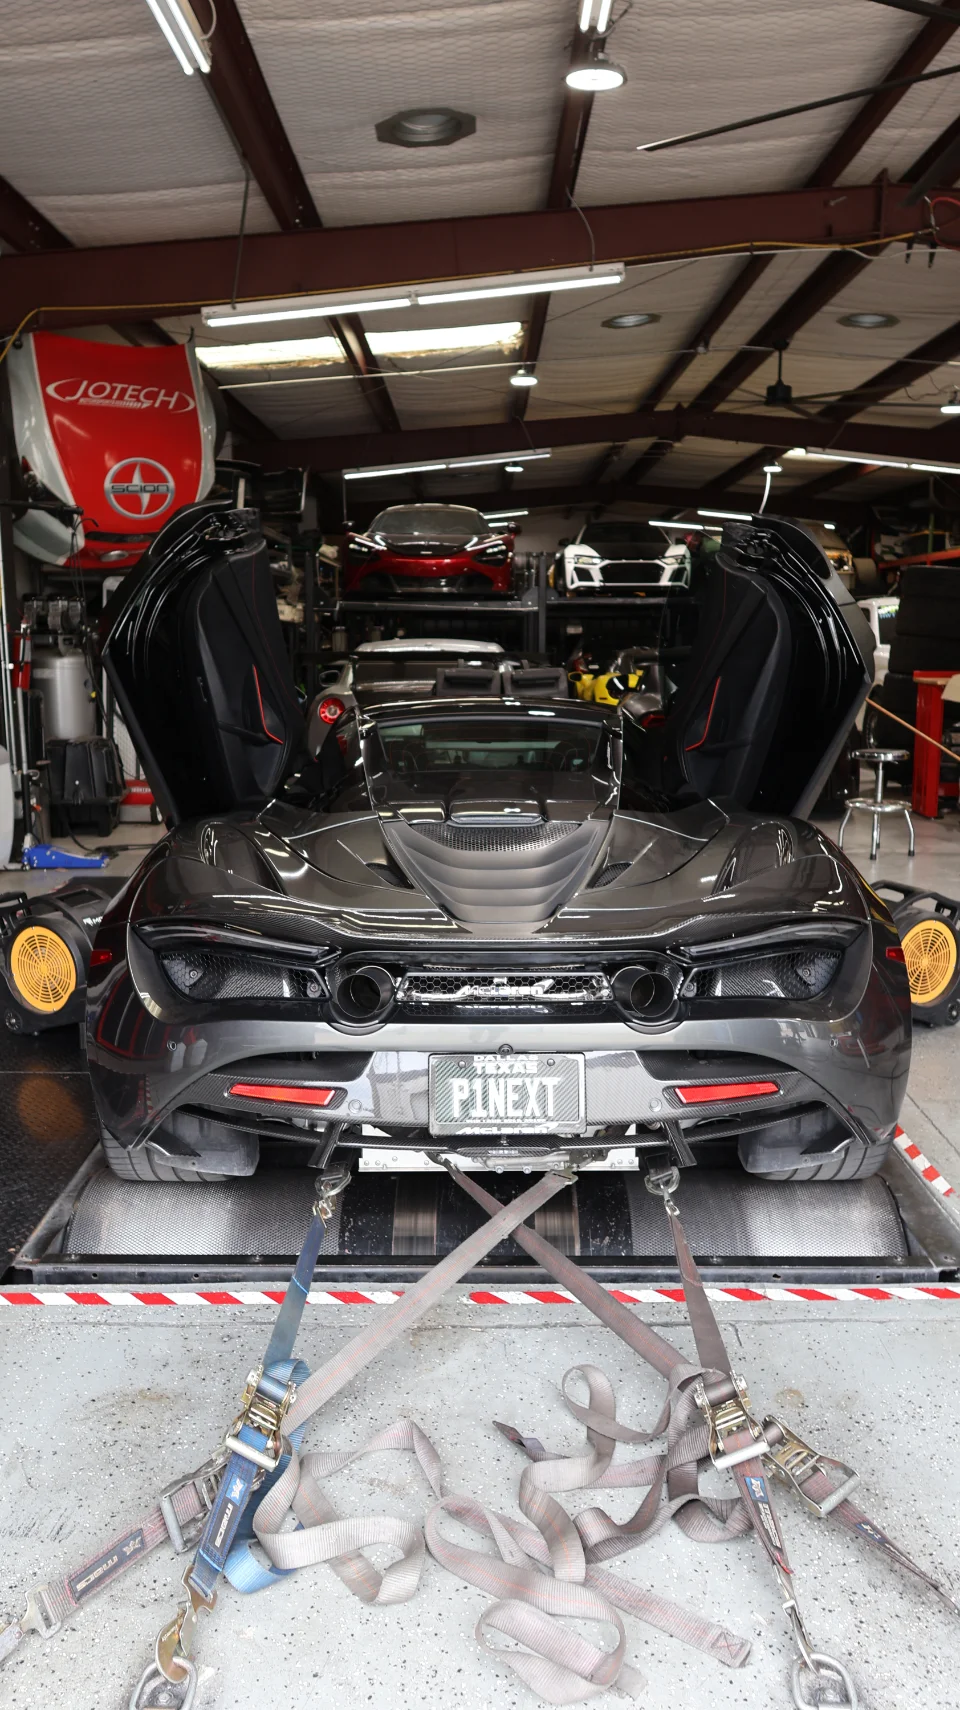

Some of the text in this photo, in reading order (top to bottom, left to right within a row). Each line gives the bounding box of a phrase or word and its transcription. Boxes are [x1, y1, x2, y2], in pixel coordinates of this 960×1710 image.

[65, 380, 179, 410] JOTECH
[456, 985, 544, 996] McLaren
[473, 1054, 539, 1062] DALLAS
[473, 1062, 538, 1075] TEXAS
[451, 1078, 561, 1118] P1NEXT
[456, 1126, 548, 1135] McLaren
